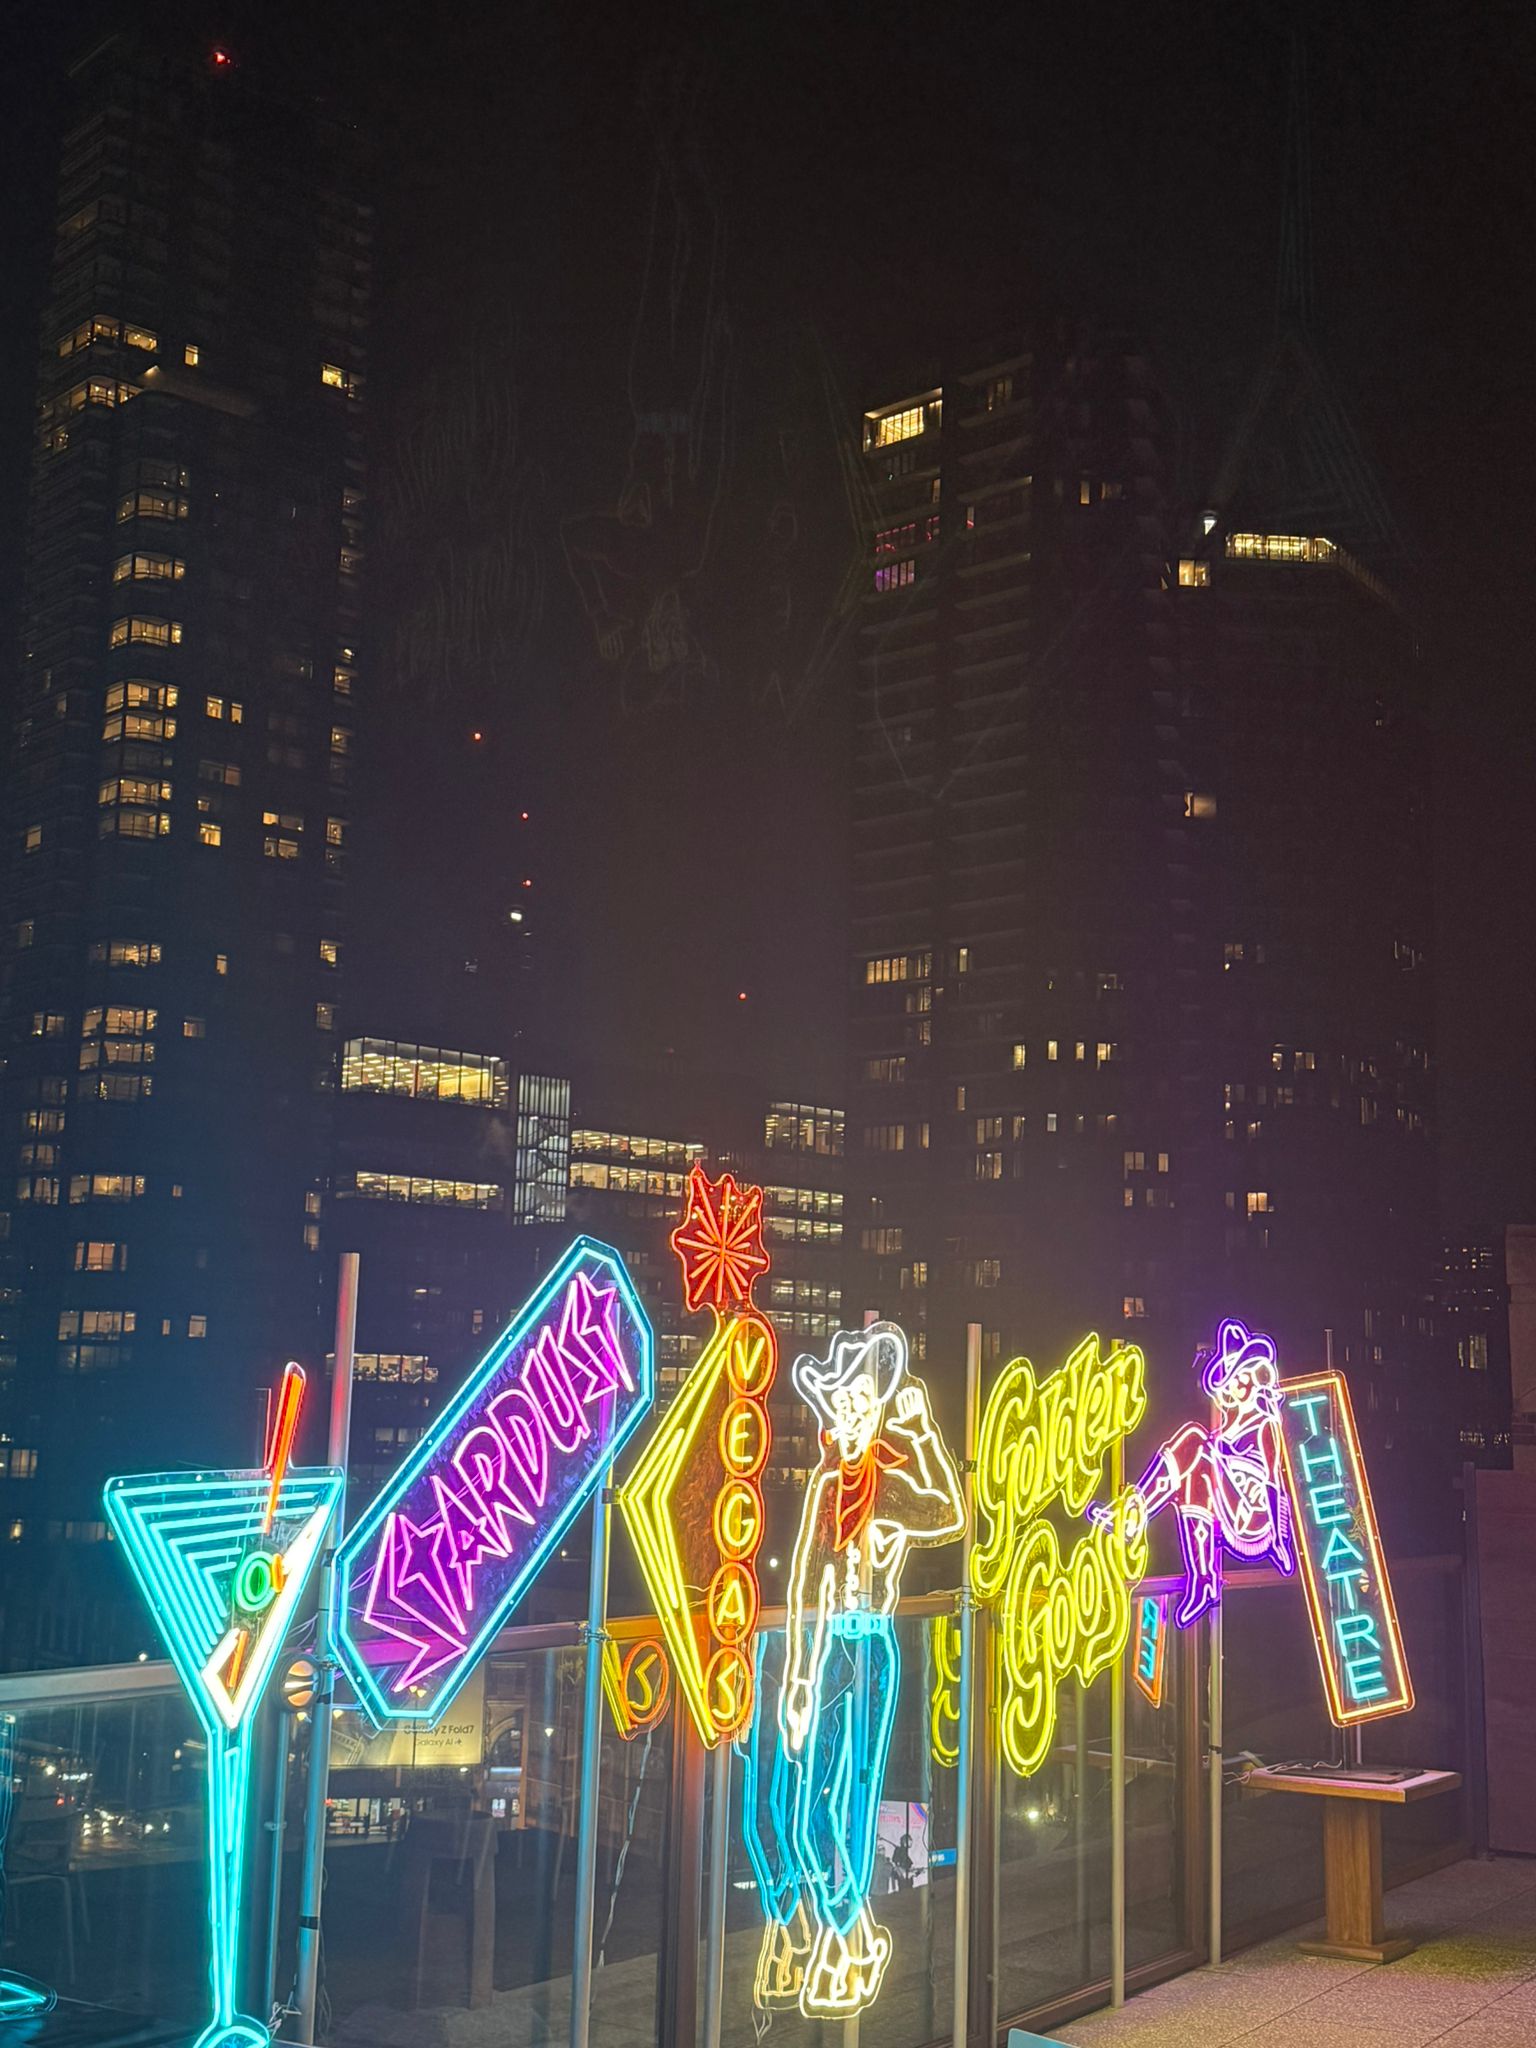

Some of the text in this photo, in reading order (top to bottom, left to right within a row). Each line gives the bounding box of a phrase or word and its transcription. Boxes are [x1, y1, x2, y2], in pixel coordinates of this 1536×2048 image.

[363, 1270, 634, 1693] STARDUST
[711, 1336, 766, 1720] VEGAS
[973, 1336, 1145, 1592] Golden
[1288, 1395, 1388, 1700] THEATRE
[441, 1725, 447, 1734] Z
[448, 1725, 474, 1734] Fold7
[1003, 1490, 1146, 1767] Goose
